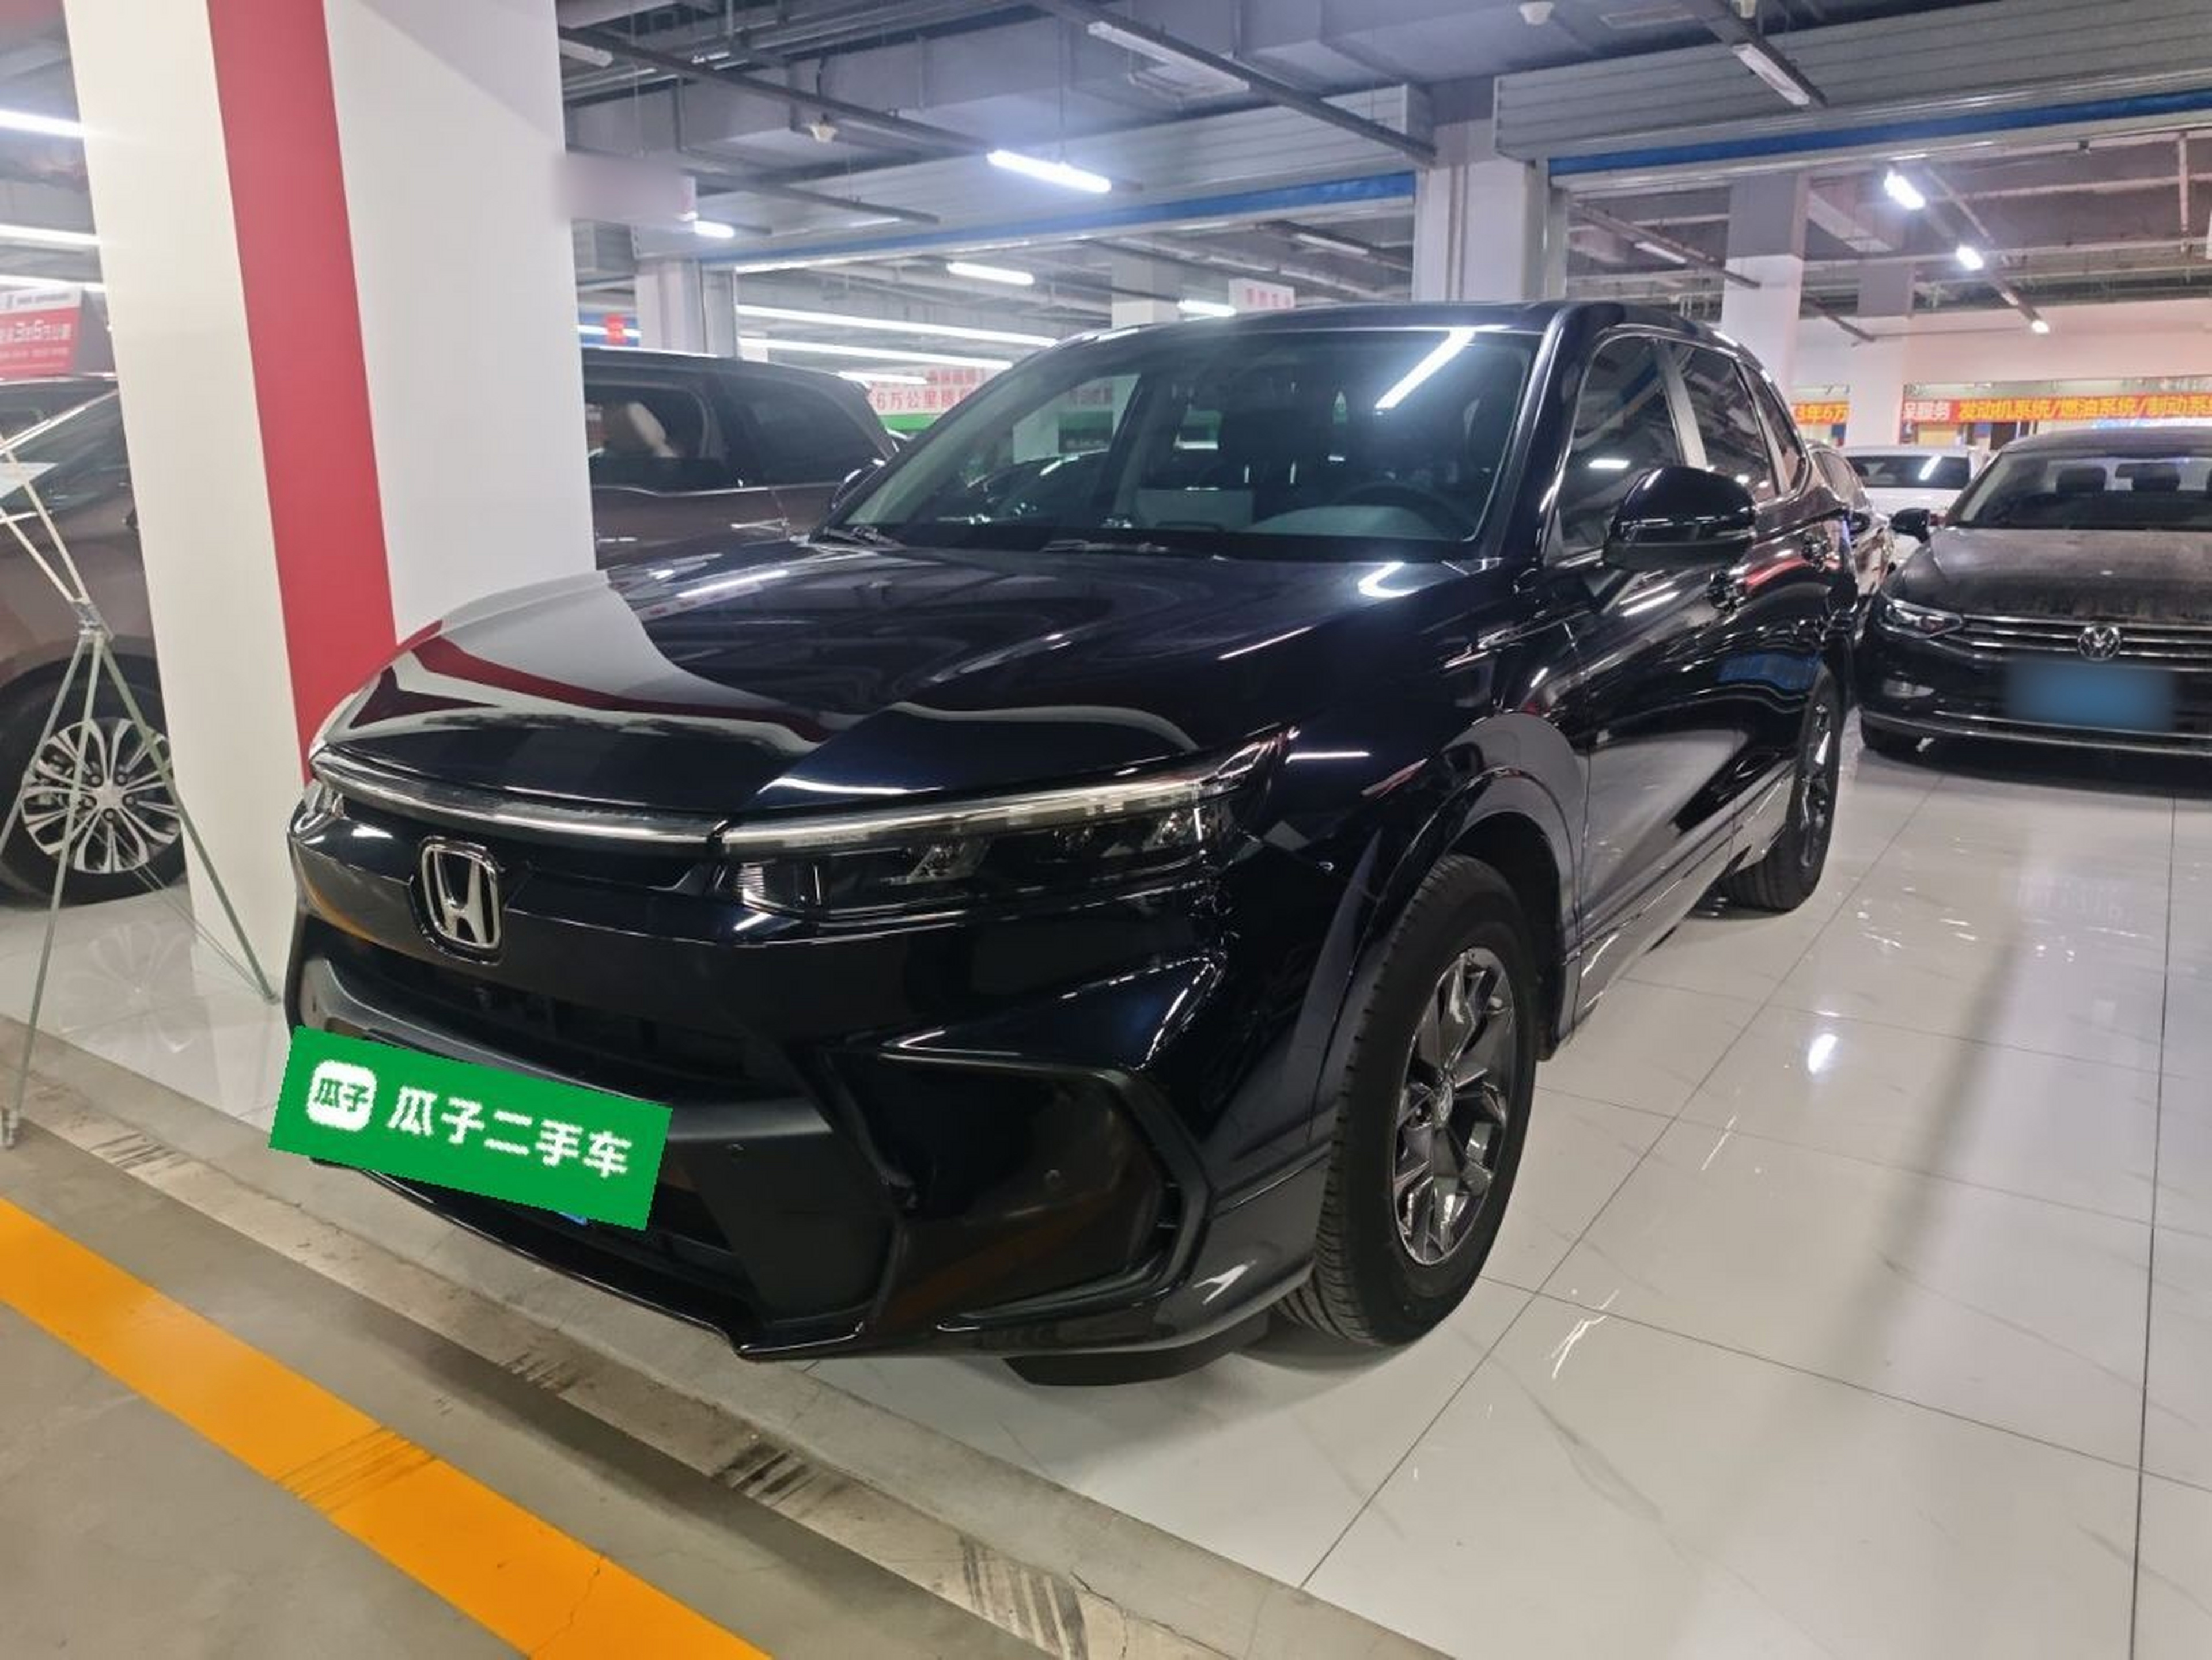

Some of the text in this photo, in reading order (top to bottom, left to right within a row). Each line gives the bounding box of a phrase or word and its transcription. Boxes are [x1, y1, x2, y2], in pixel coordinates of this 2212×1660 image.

[1960, 395, 2212, 420] 发动机系统/燃油系统/制动系
